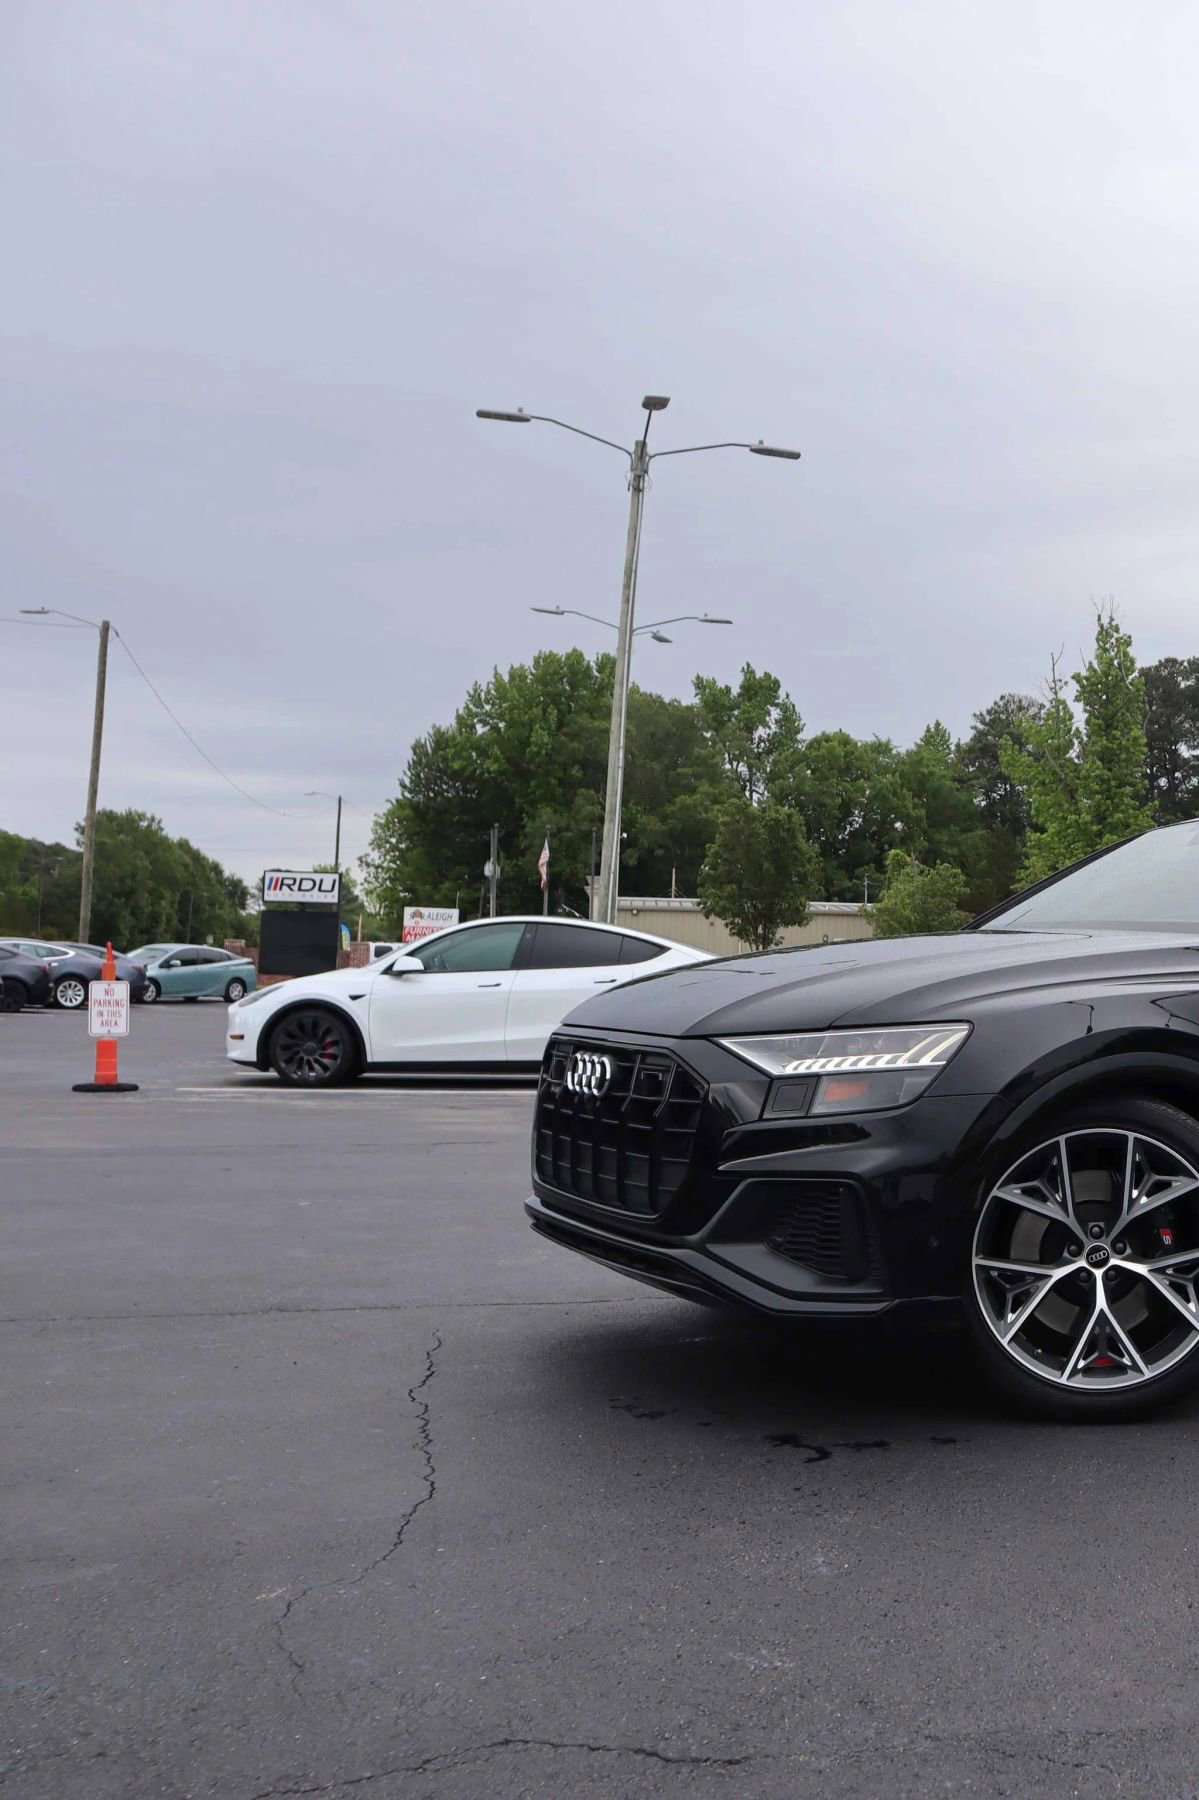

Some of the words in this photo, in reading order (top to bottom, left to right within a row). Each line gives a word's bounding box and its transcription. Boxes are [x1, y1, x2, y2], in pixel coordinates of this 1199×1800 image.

[279, 876, 337, 893] RDU
[104, 987, 115, 997] NO
[93, 998, 125, 1009] PARKING
[96, 1010, 104, 1018] IN
[106, 1010, 122, 1018] THIS
[100, 1019, 118, 1028] AREA
